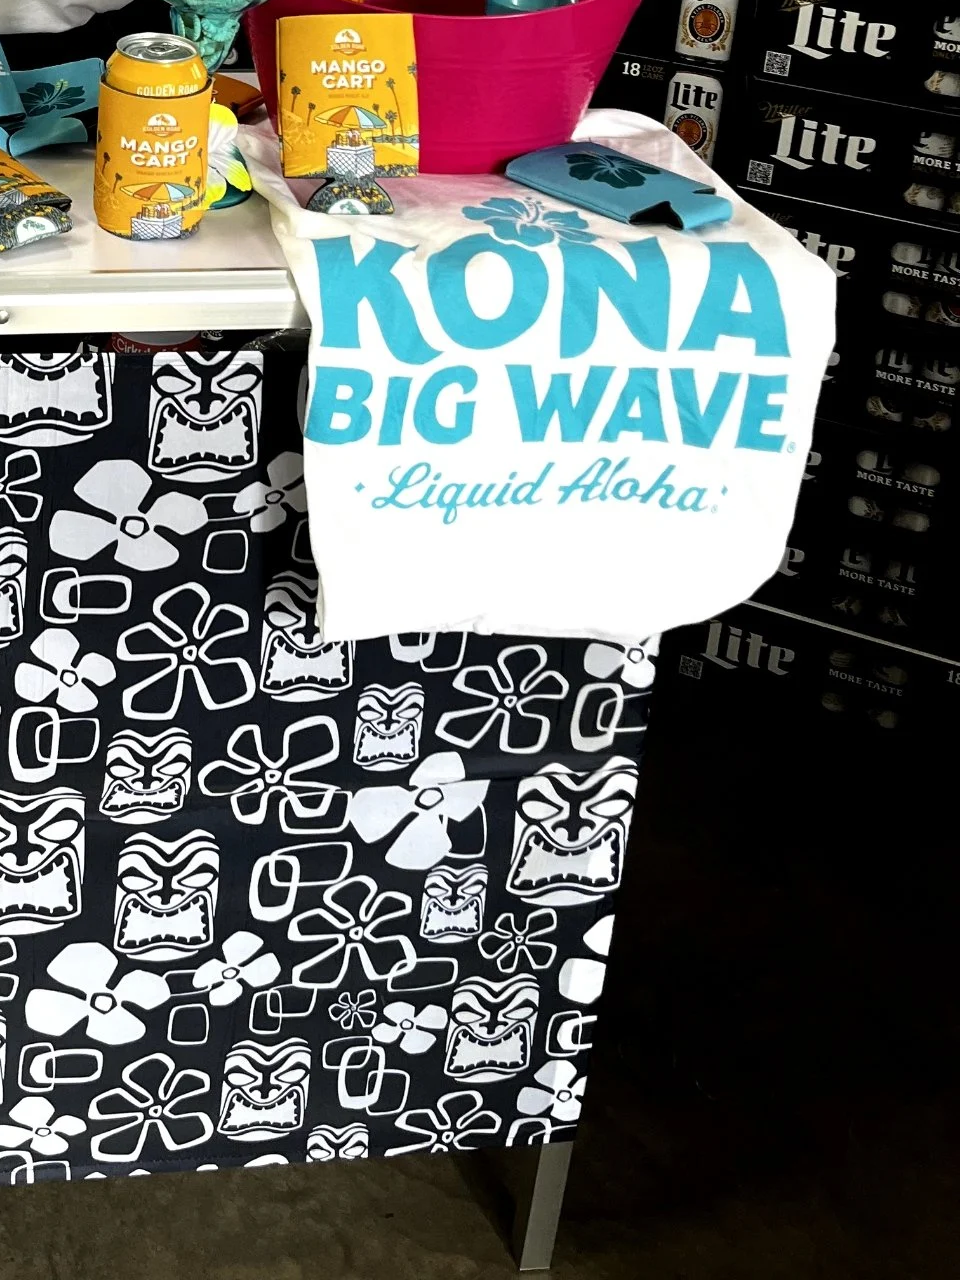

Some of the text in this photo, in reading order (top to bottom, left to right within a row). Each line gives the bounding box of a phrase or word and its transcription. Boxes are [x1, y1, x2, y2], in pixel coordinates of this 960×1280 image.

[787, 0, 896, 60] Lite
[311, 60, 386, 74] MANGO
[322, 75, 375, 89] CART
[137, 84, 198, 96] GOLDEN ROAD
[120, 136, 198, 153] MANGO
[130, 152, 190, 167] CART
[770, 112, 876, 171] Lite
[309, 236, 791, 366] KONA
[303, 363, 789, 453] BIG WAVE
[371, 456, 706, 525] Liquid Aloha
